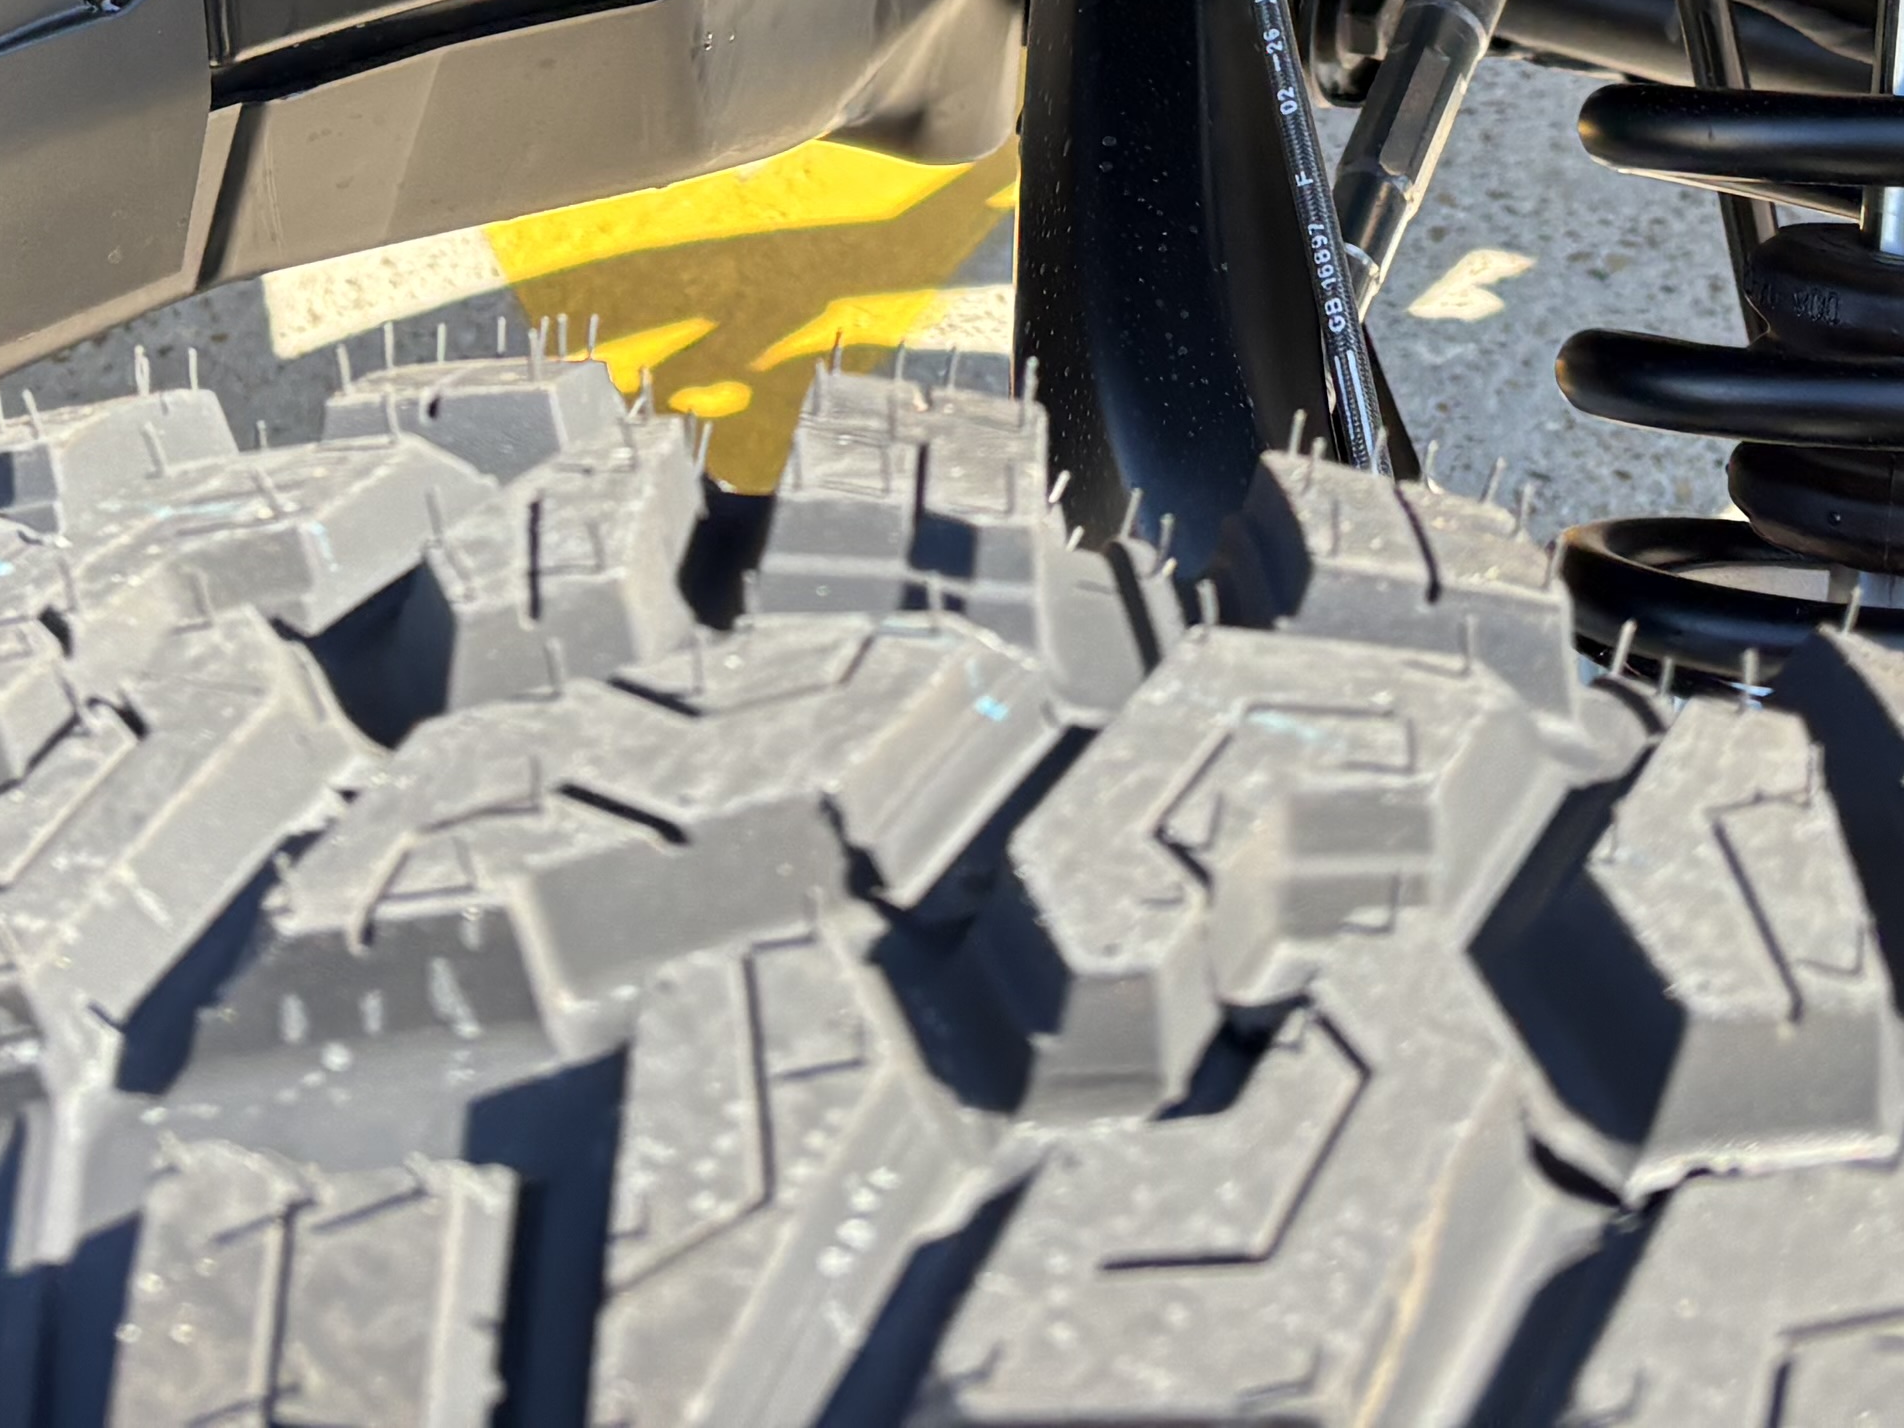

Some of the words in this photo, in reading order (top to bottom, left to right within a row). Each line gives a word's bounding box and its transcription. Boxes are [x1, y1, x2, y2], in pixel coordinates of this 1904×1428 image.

[1295, 170, 1315, 186] F
[1306, 222, 1338, 290] 16897
[1323, 296, 1347, 333] GB
